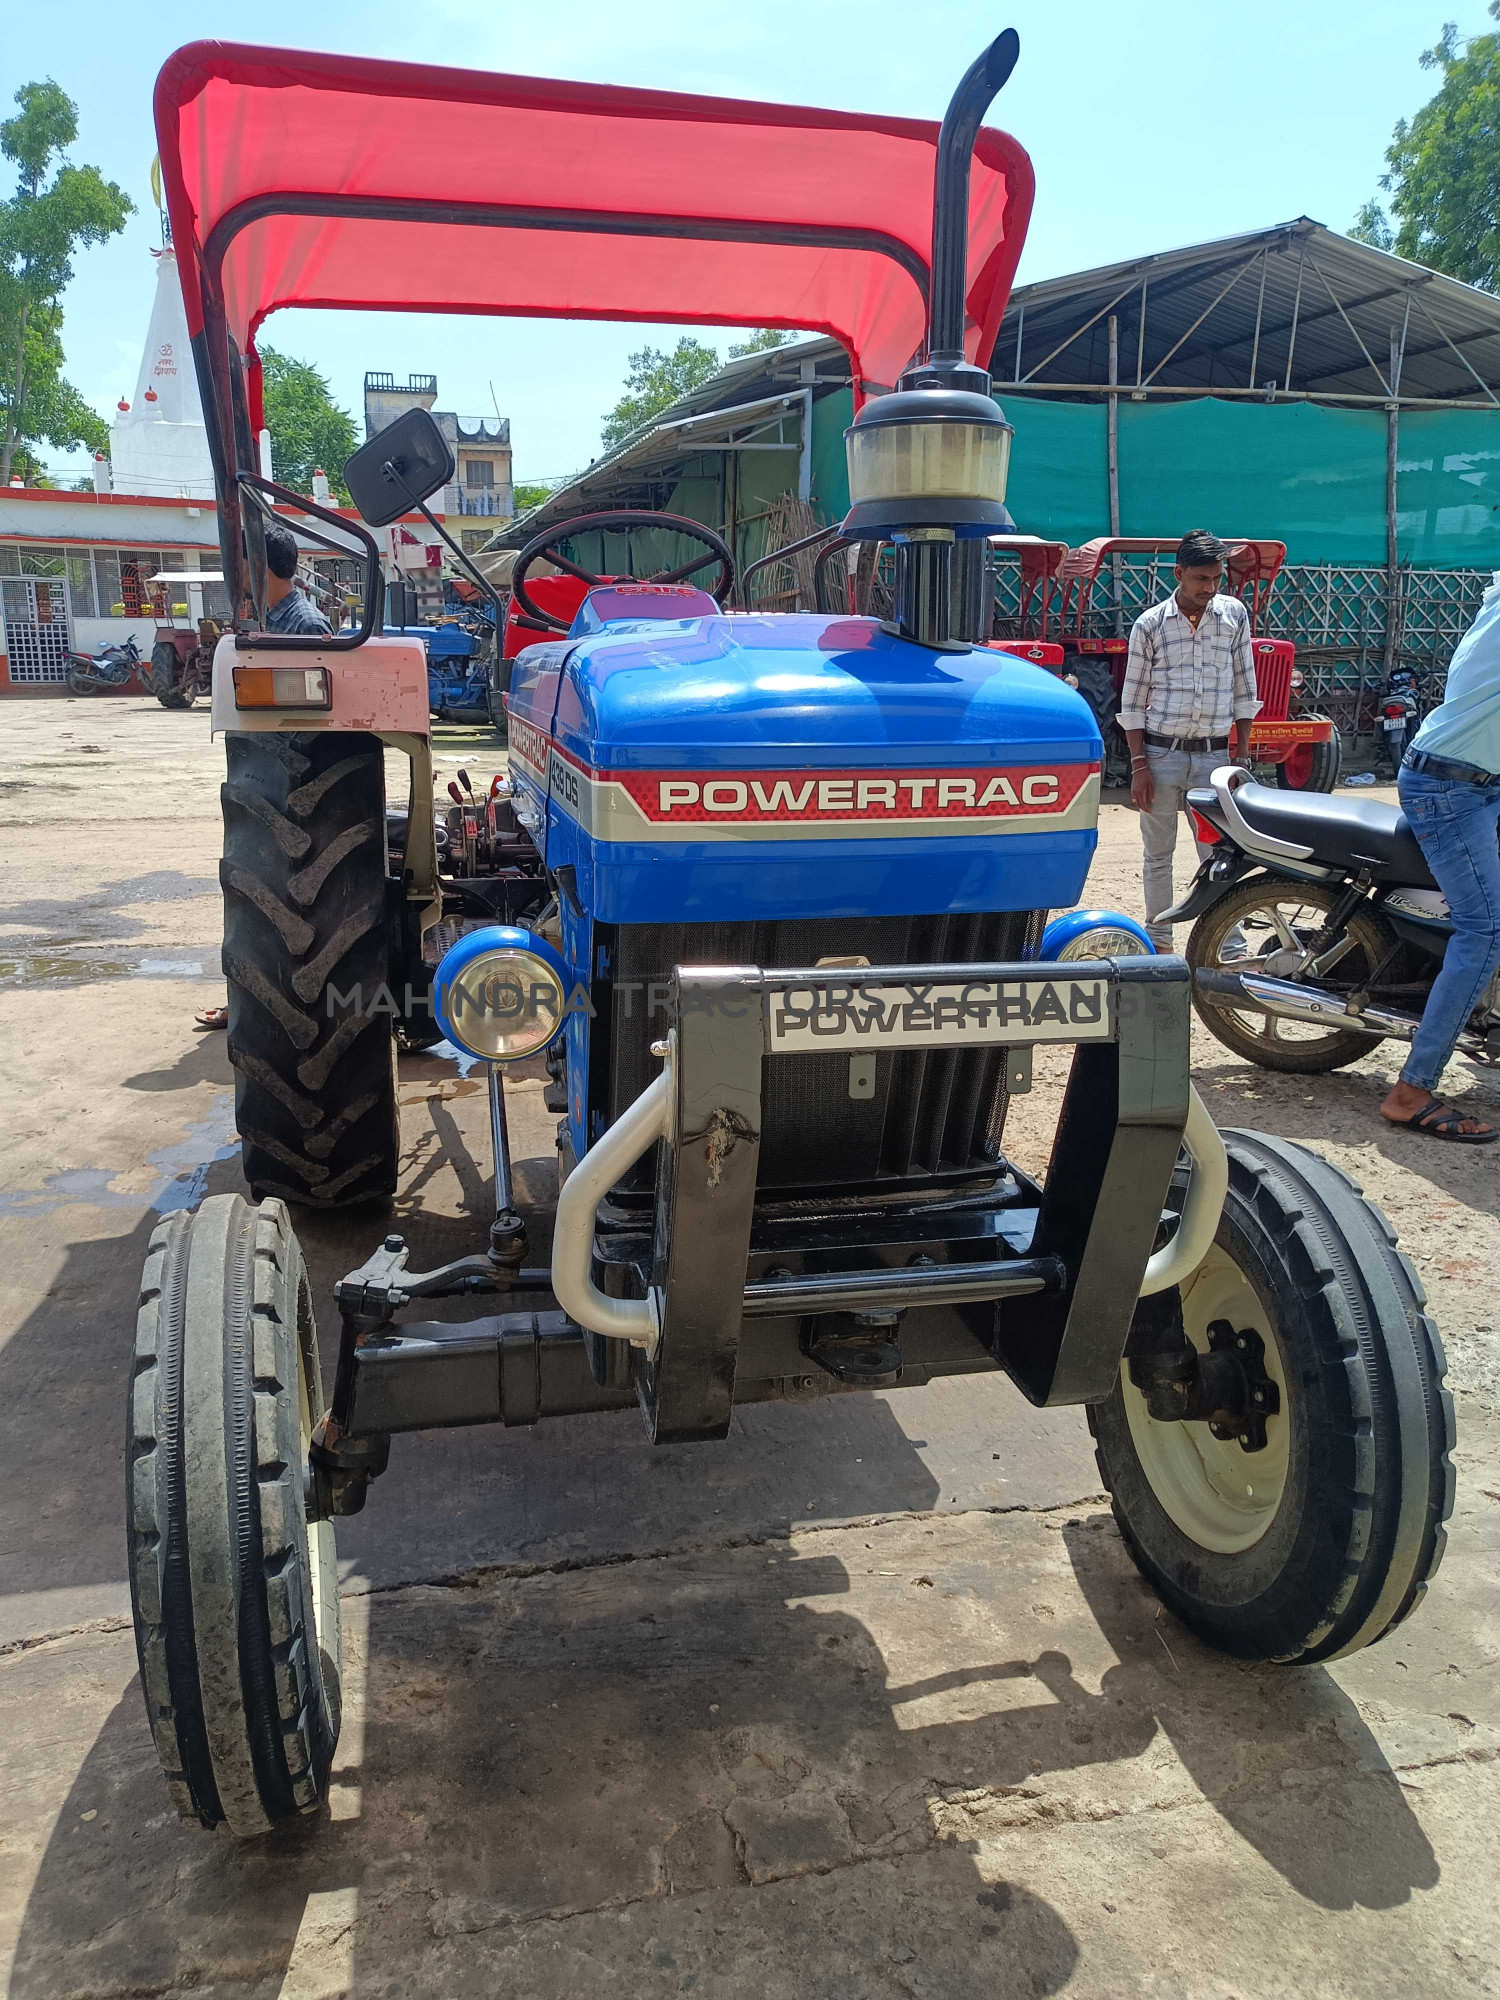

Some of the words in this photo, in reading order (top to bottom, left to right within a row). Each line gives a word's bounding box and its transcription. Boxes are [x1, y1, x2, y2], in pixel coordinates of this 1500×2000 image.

[154, 366, 177, 376] शिवाय
[512, 719, 546, 769] POWERTRAC
[551, 758, 564, 796] 439
[565, 771, 579, 808] DS
[659, 775, 1059, 811] POWERTRAC
